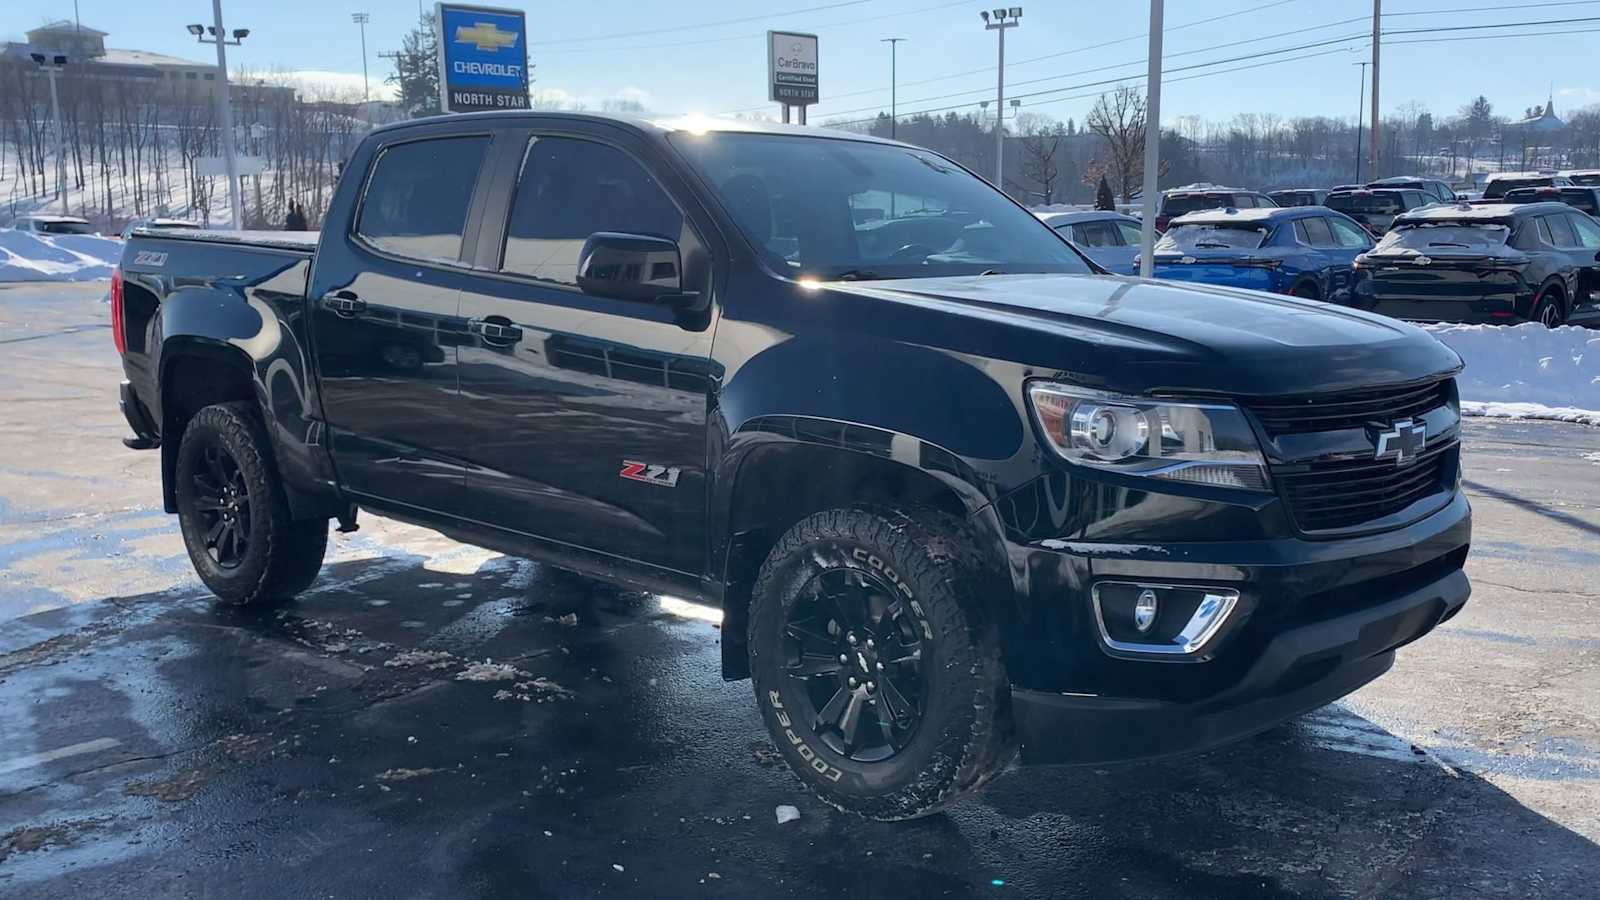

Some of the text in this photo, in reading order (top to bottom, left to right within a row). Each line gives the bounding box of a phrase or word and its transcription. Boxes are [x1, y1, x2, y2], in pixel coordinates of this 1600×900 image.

[454, 61, 520, 77] CHEVROLET
[454, 92, 525, 108] NORTH STAR
[619, 460, 681, 488] Z71
[853, 547, 933, 640] COOPER
[768, 690, 842, 782] COOPER
